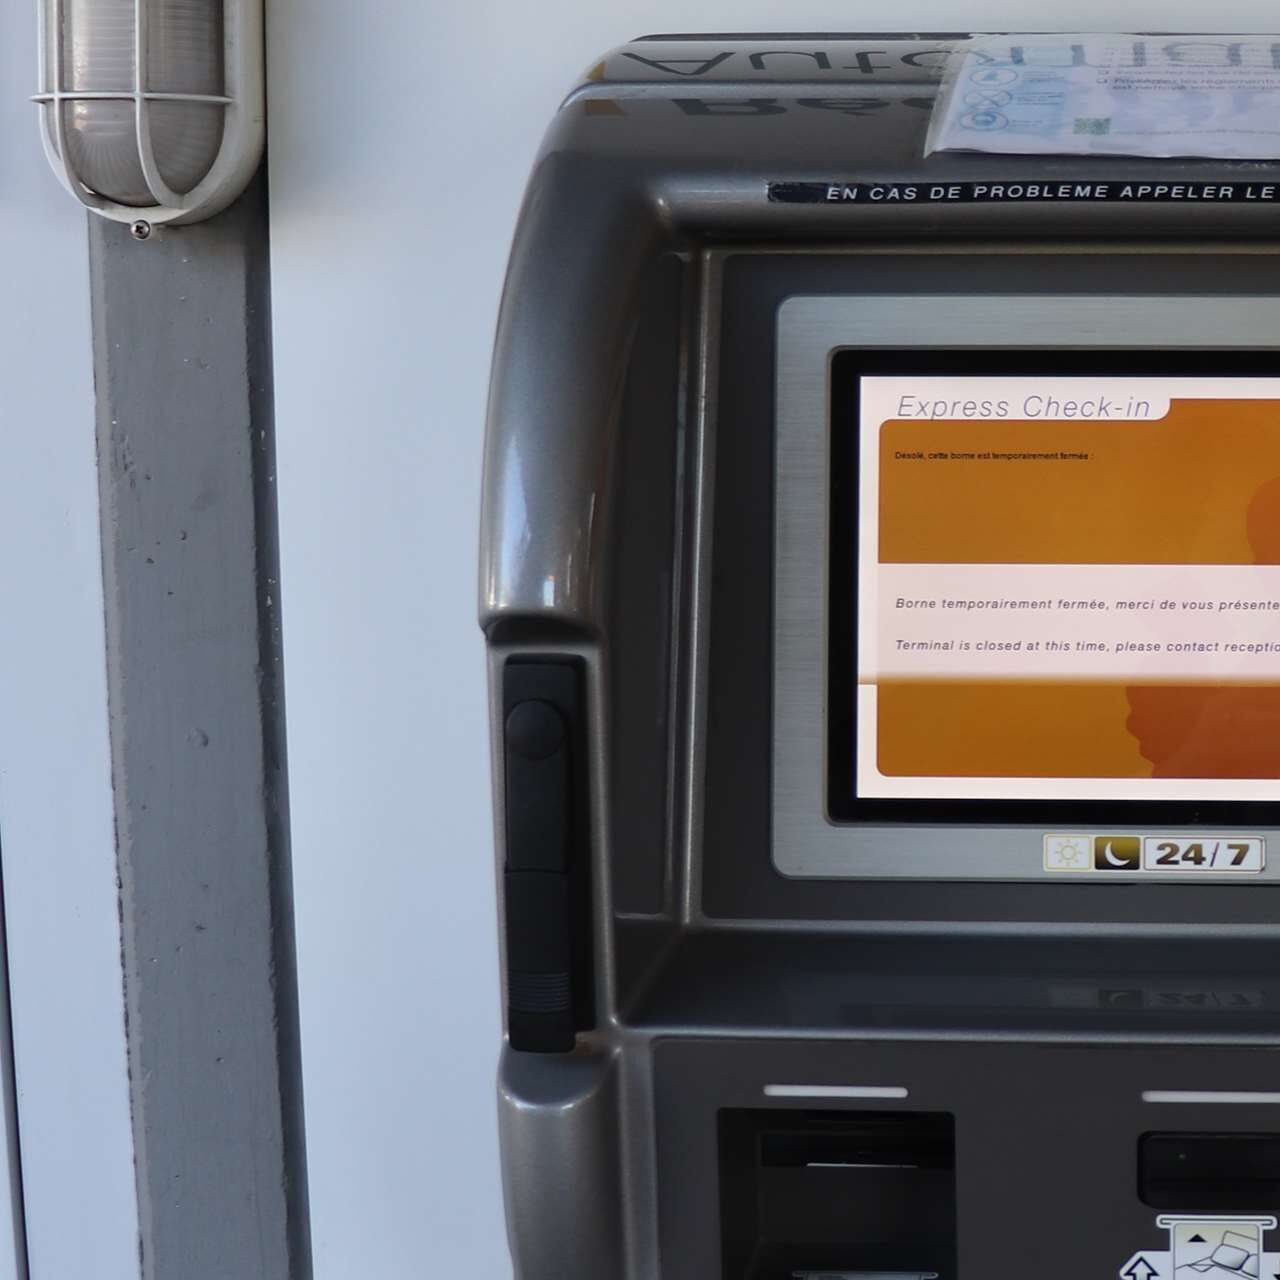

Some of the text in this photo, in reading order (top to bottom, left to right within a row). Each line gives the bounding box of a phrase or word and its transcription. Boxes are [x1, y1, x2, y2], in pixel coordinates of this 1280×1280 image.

[827, 184, 857, 199] EN
[870, 187, 917, 200] CAS
[930, 187, 961, 199] DE
[974, 185, 1108, 198] PROBLEME
[1120, 186, 1233, 198] APPELER
[1246, 187, 1275, 198] LE
[897, 396, 1149, 419] Express Check-in
[896, 598, 936, 608] Borne
[942, 599, 1052, 611] temporairement
[1058, 600, 1109, 610] fermée,
[1116, 600, 1155, 609] merci
[1160, 600, 1176, 609] de
[896, 640, 954, 650] Terminal
[959, 640, 970, 650] is
[976, 641, 1022, 650] closed
[1027, 642, 1040, 651] at
[1045, 641, 1070, 651] this
[1076, 641, 1109, 652] time,
[1115, 641, 1161, 653] please
[1166, 642, 1219, 652] contact
[1155, 842, 1250, 867] 24/7
